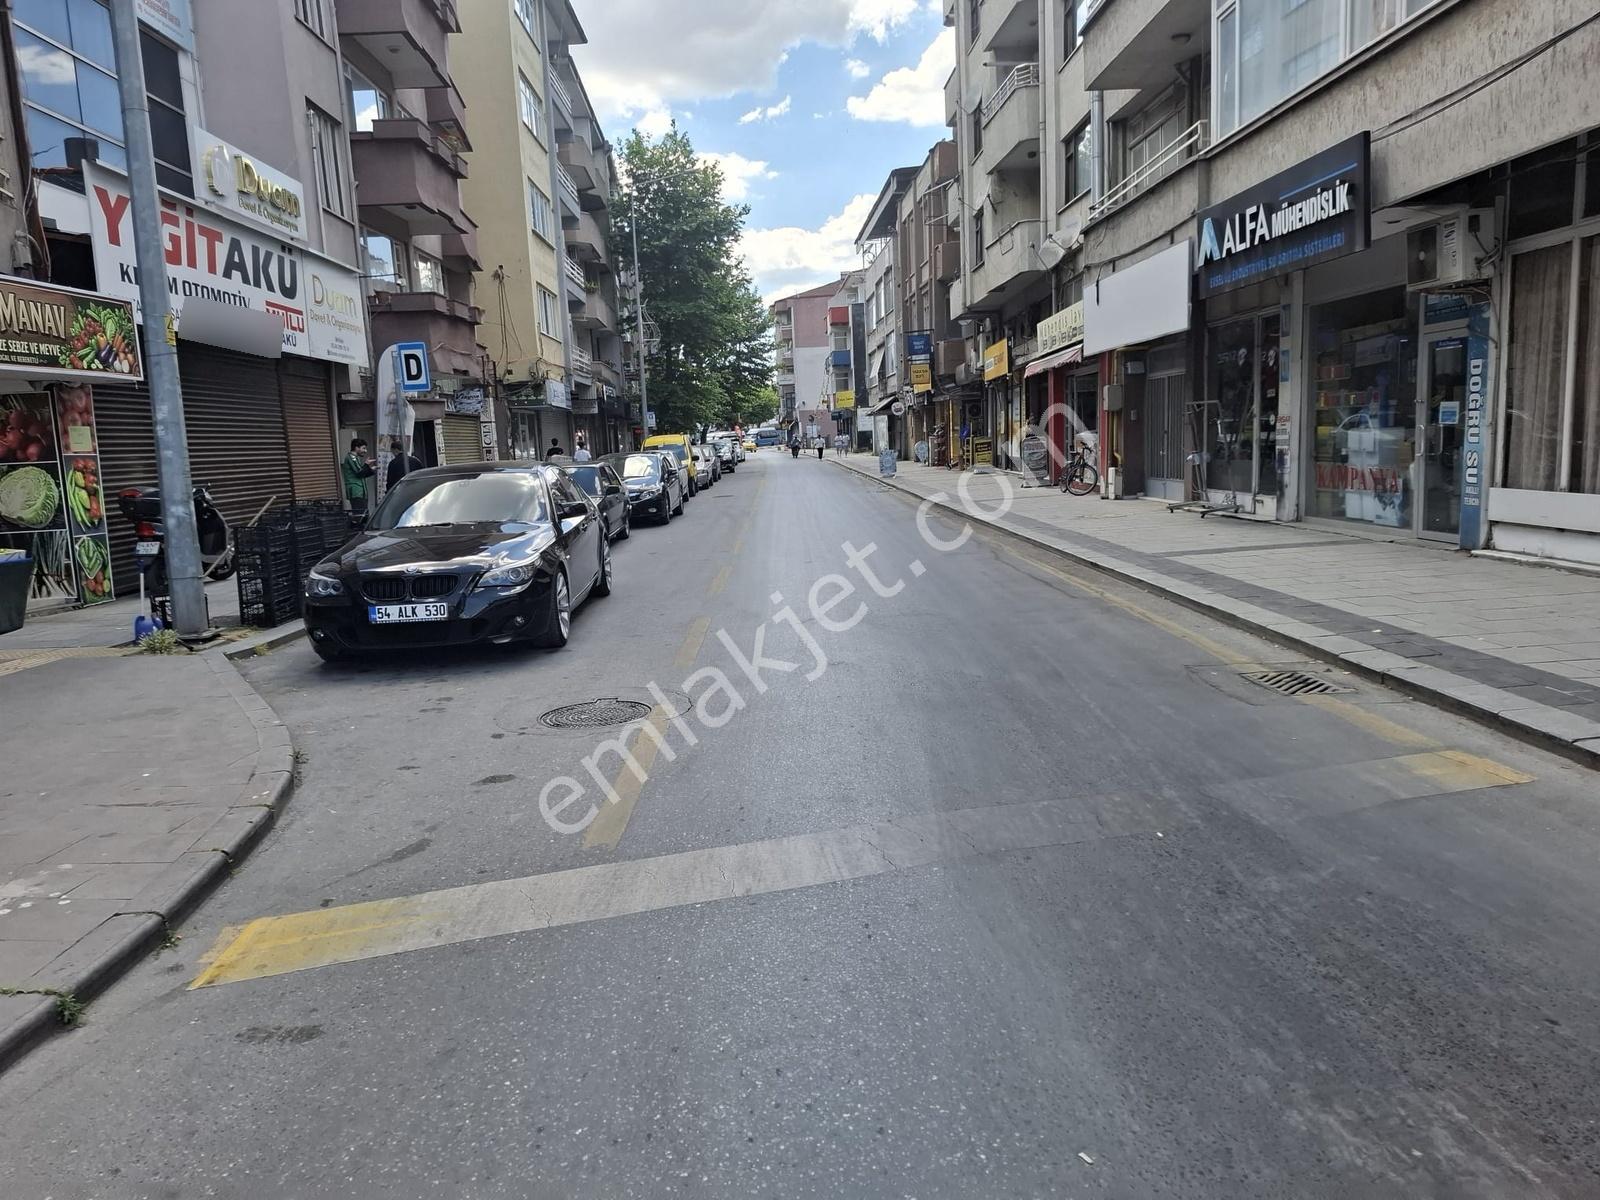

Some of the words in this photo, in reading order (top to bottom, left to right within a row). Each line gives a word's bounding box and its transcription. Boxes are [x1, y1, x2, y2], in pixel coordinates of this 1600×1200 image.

[1222, 203, 1271, 258] ALFA
[1272, 179, 1350, 239] MÜHENDİSLİK
[0, 291, 65, 339] MANAV
[8, 341, 29, 354] SEBZE
[29, 342, 39, 354] VE
[39, 343, 61, 356] MEYVE
[404, 353, 423, 381] D
[1467, 358, 1484, 445] DOĞRU
[1465, 452, 1480, 484] SU
[376, 607, 391, 620] 54
[398, 605, 418, 619] ALK
[424, 604, 446, 617] 530
